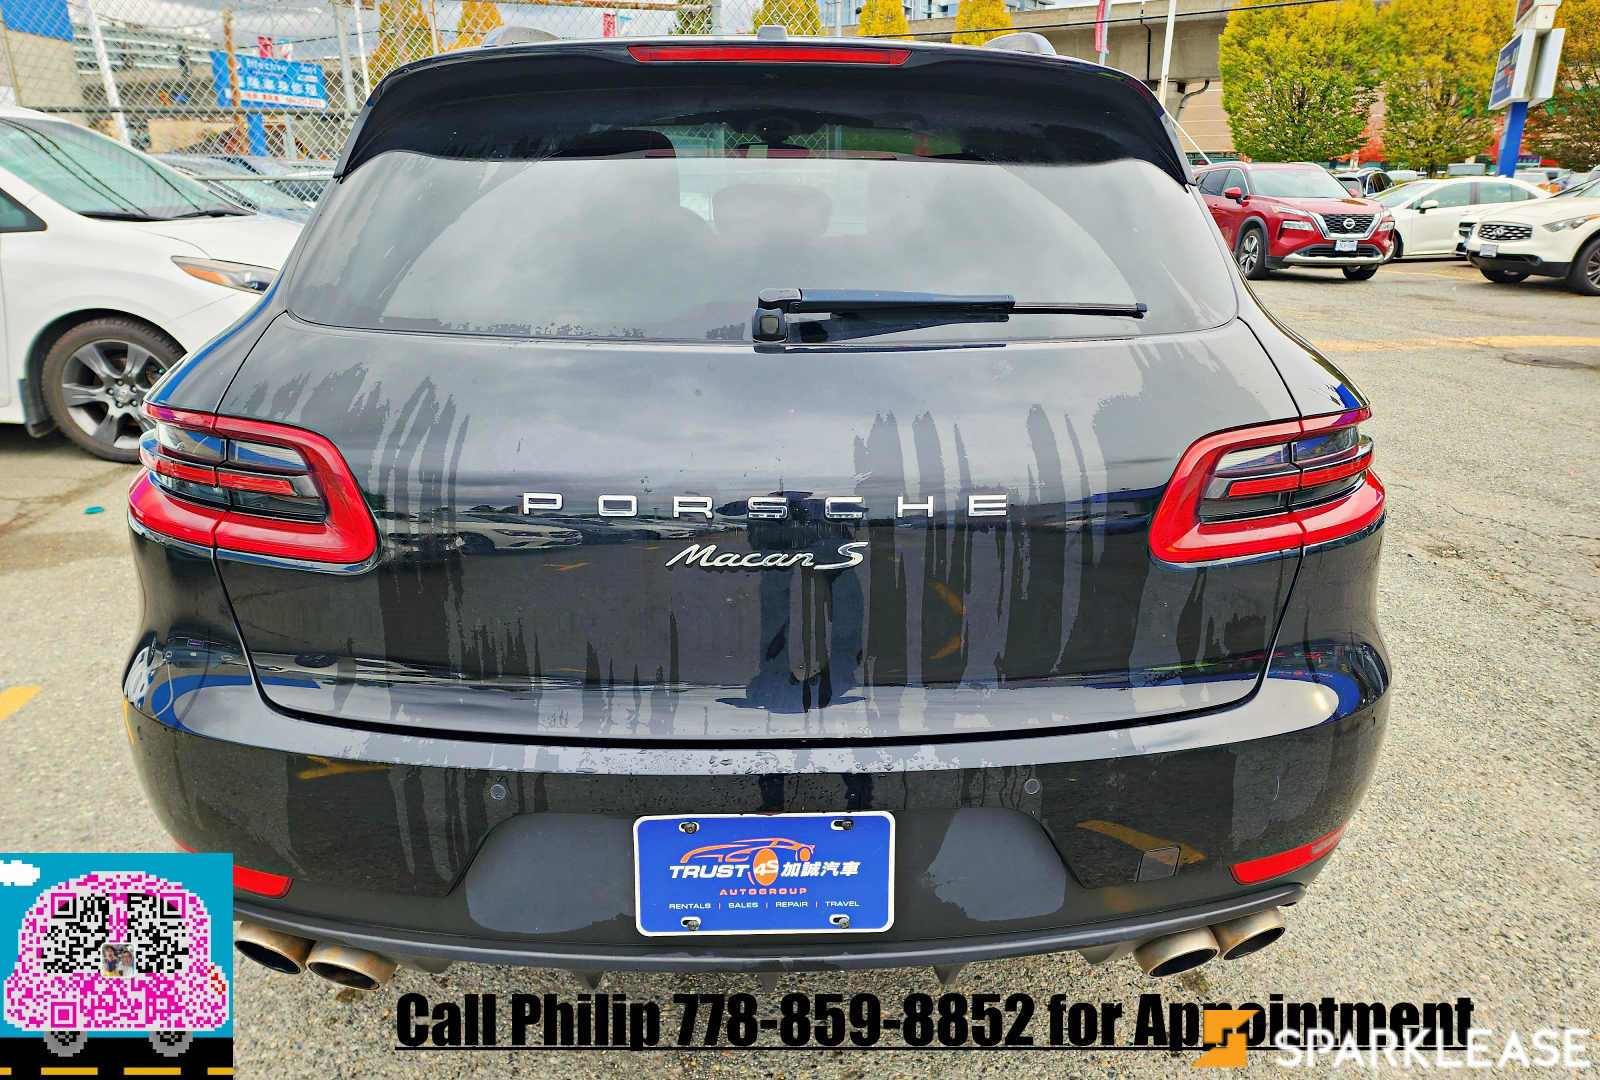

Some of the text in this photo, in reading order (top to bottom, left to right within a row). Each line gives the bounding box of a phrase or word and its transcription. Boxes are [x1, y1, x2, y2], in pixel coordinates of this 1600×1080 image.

[523, 492, 1007, 519] PORSCHE
[665, 541, 869, 570] Macan S
[669, 860, 861, 879] TRUST 4S 加誠汽車
[719, 887, 807, 896] AUTOGROUP
[668, 902, 711, 910] RENTALS
[728, 901, 758, 909] SALES
